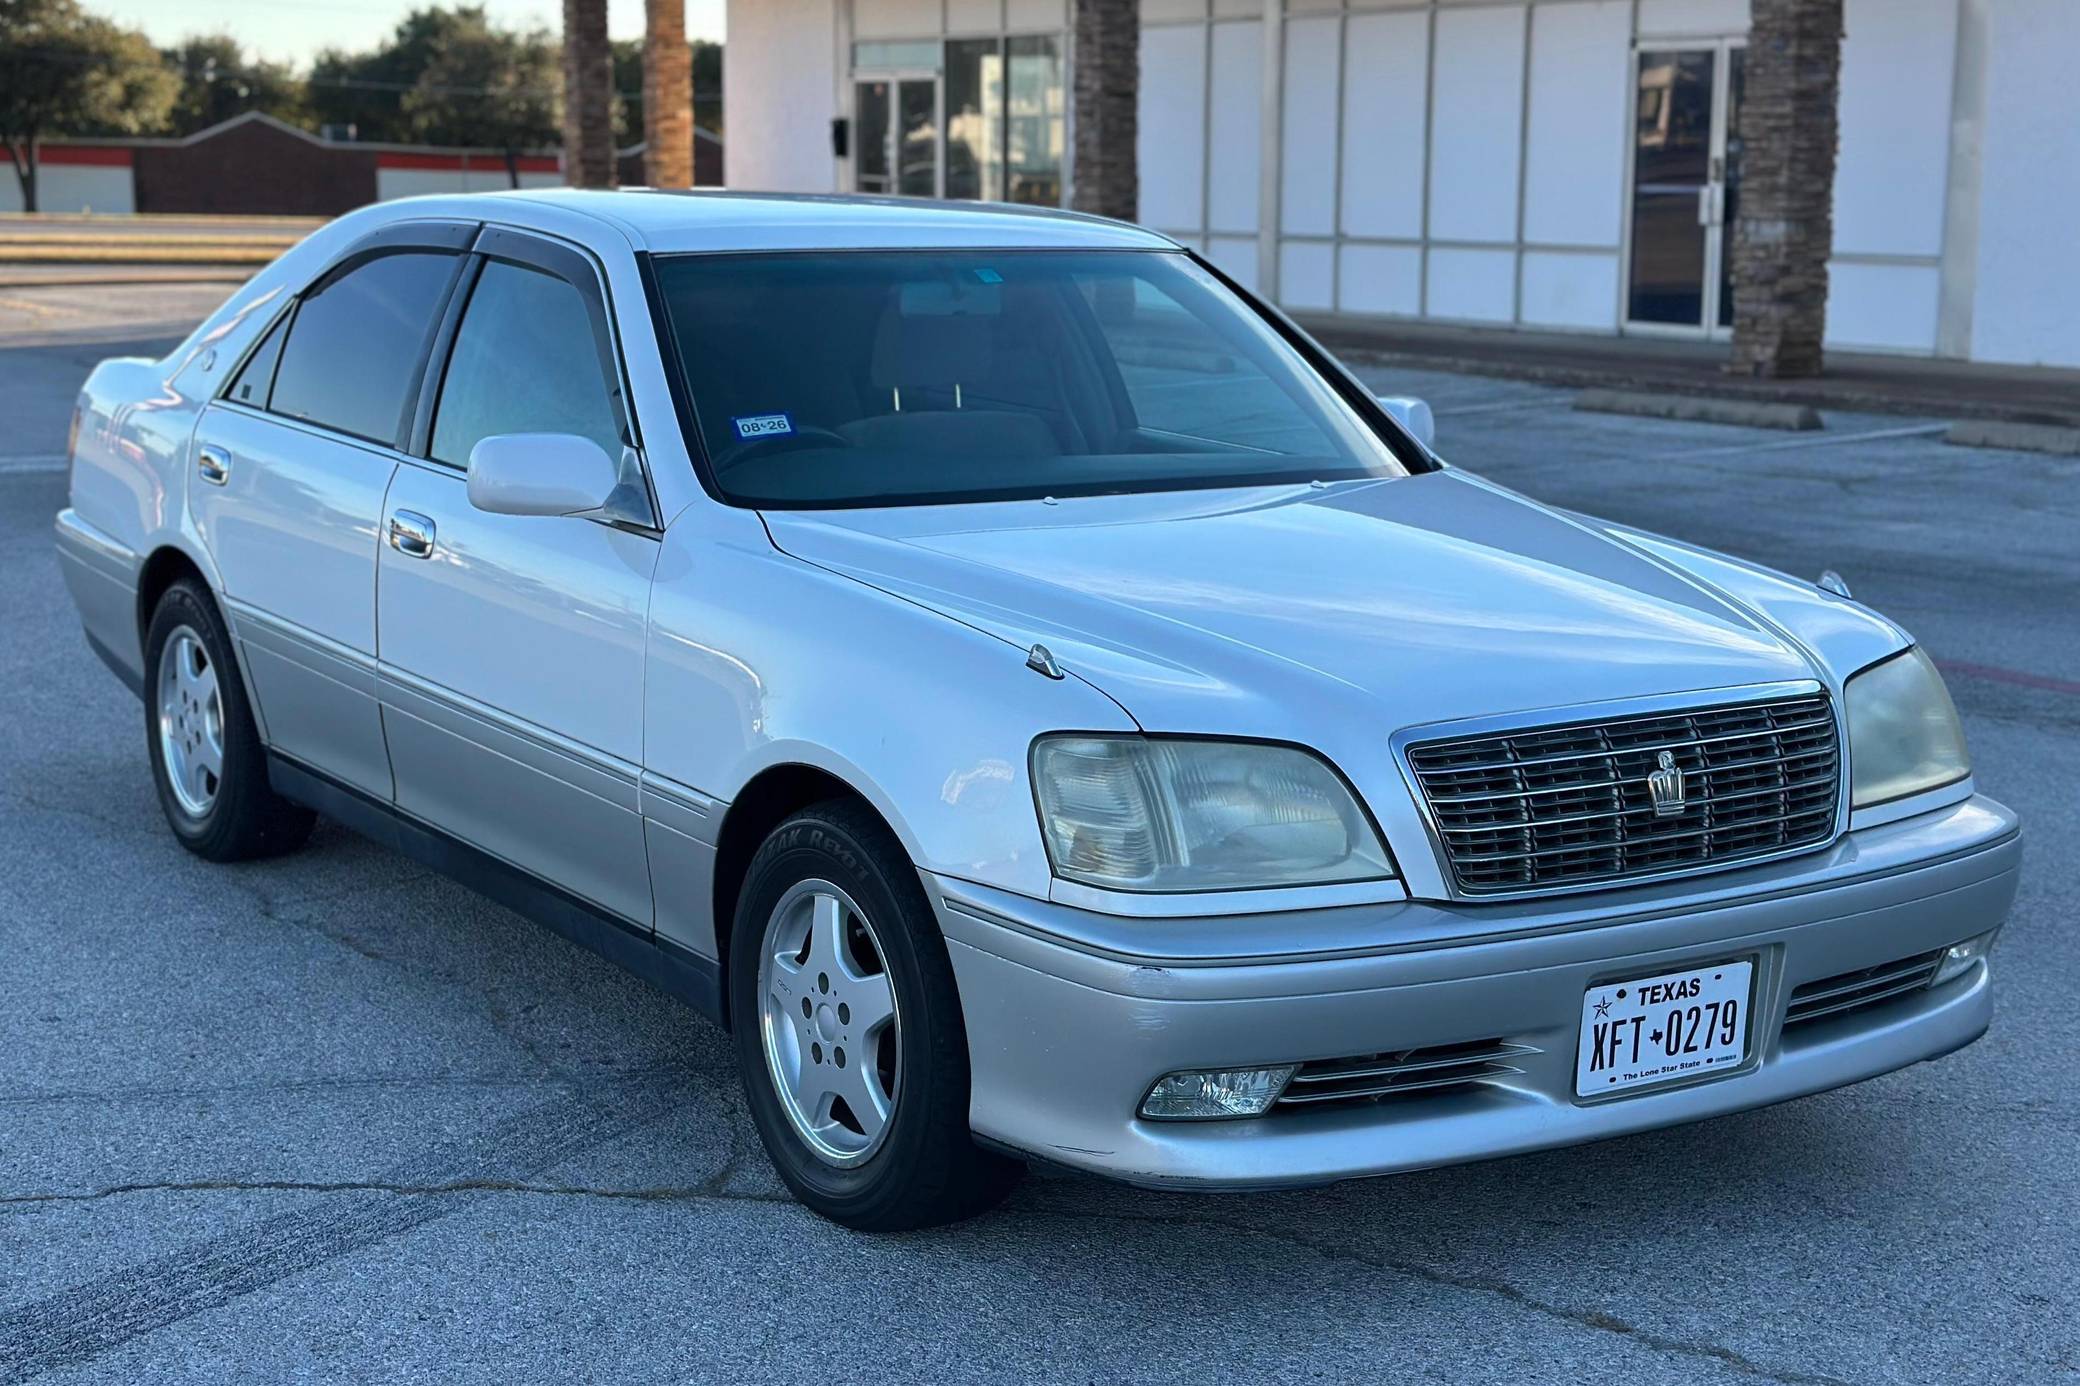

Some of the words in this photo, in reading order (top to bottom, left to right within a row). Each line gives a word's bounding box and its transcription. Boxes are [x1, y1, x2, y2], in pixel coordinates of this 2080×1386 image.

[1638, 978, 1701, 1006] TEXAS
[1623, 1073, 1638, 1081] The
[1640, 1069, 1659, 1078] Lone
[1661, 1065, 1678, 1073] Star
[1680, 1060, 1701, 1070] State
